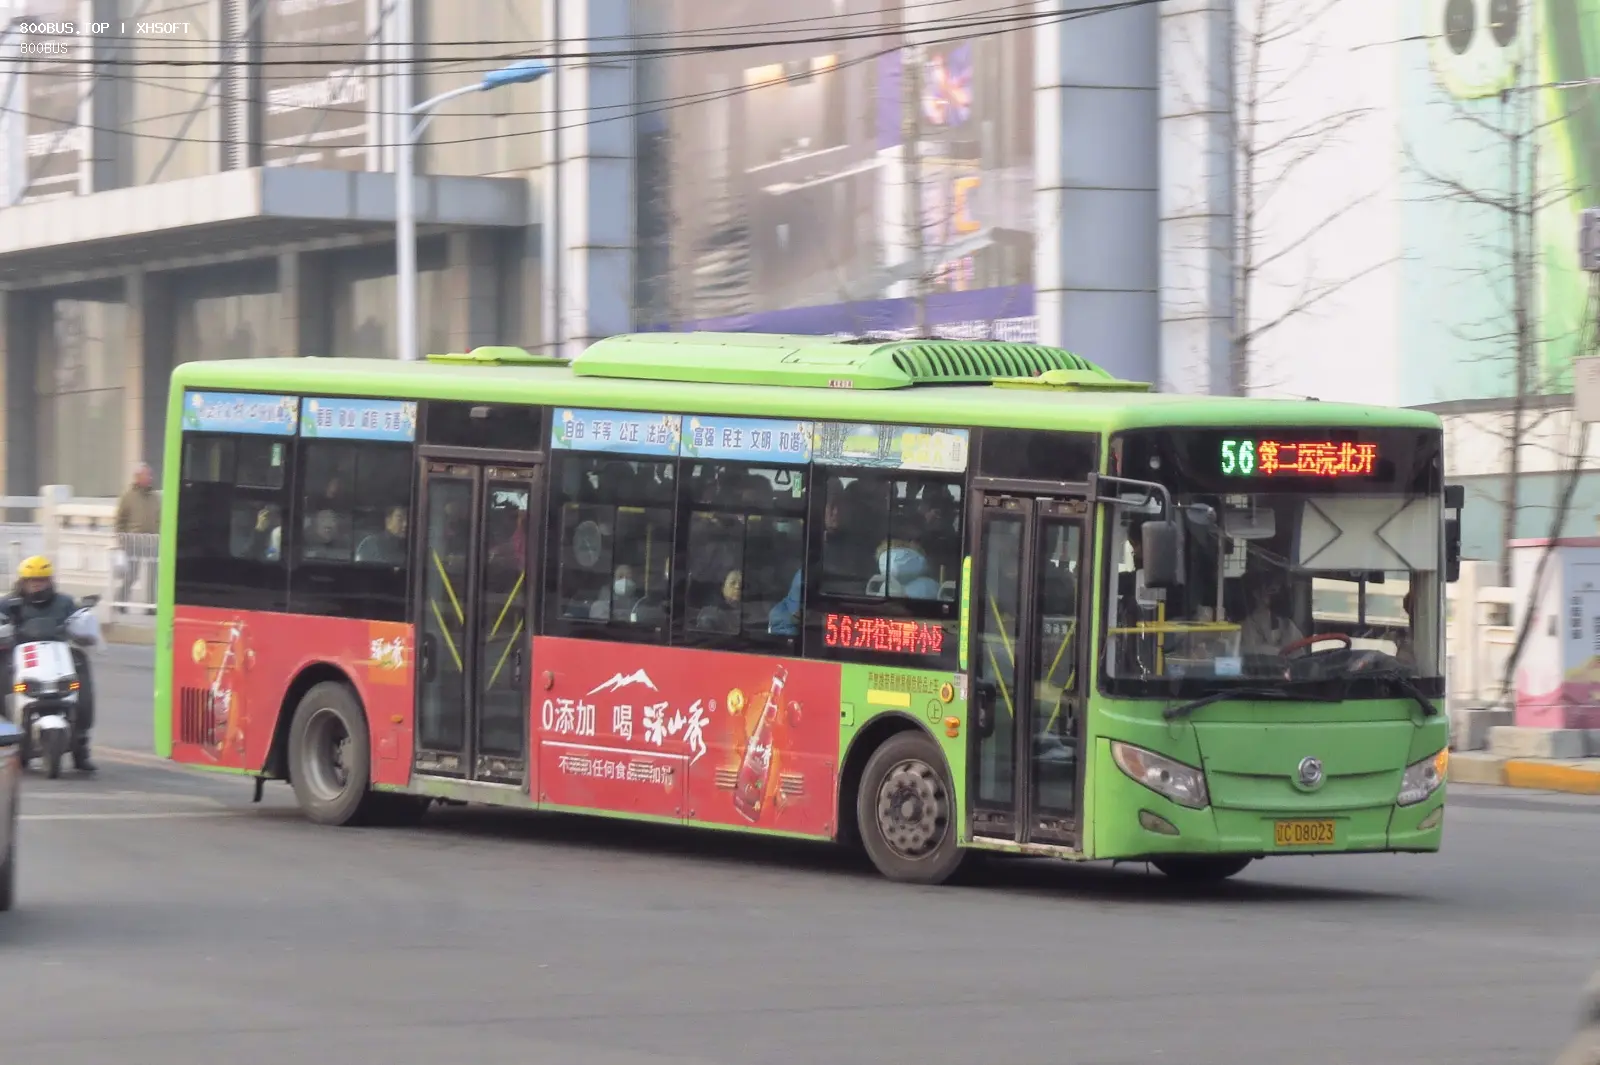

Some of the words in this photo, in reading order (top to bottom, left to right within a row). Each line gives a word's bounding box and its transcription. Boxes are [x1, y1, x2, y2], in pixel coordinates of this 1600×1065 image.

[564, 420, 585, 439] 自由
[591, 421, 612, 441] 平等
[619, 423, 639, 442] 公正
[646, 424, 668, 444] 法治
[693, 427, 715, 447] 富强
[722, 429, 742, 448] 民主
[750, 430, 771, 449] 文明
[779, 431, 801, 451] 和谐
[1221, 440, 1254, 474] 56
[1259, 440, 1376, 475] 第二医院北开
[541, 697, 596, 737] 0添加
[612, 704, 633, 741] 喝
[1294, 823, 1333, 842] D8023
